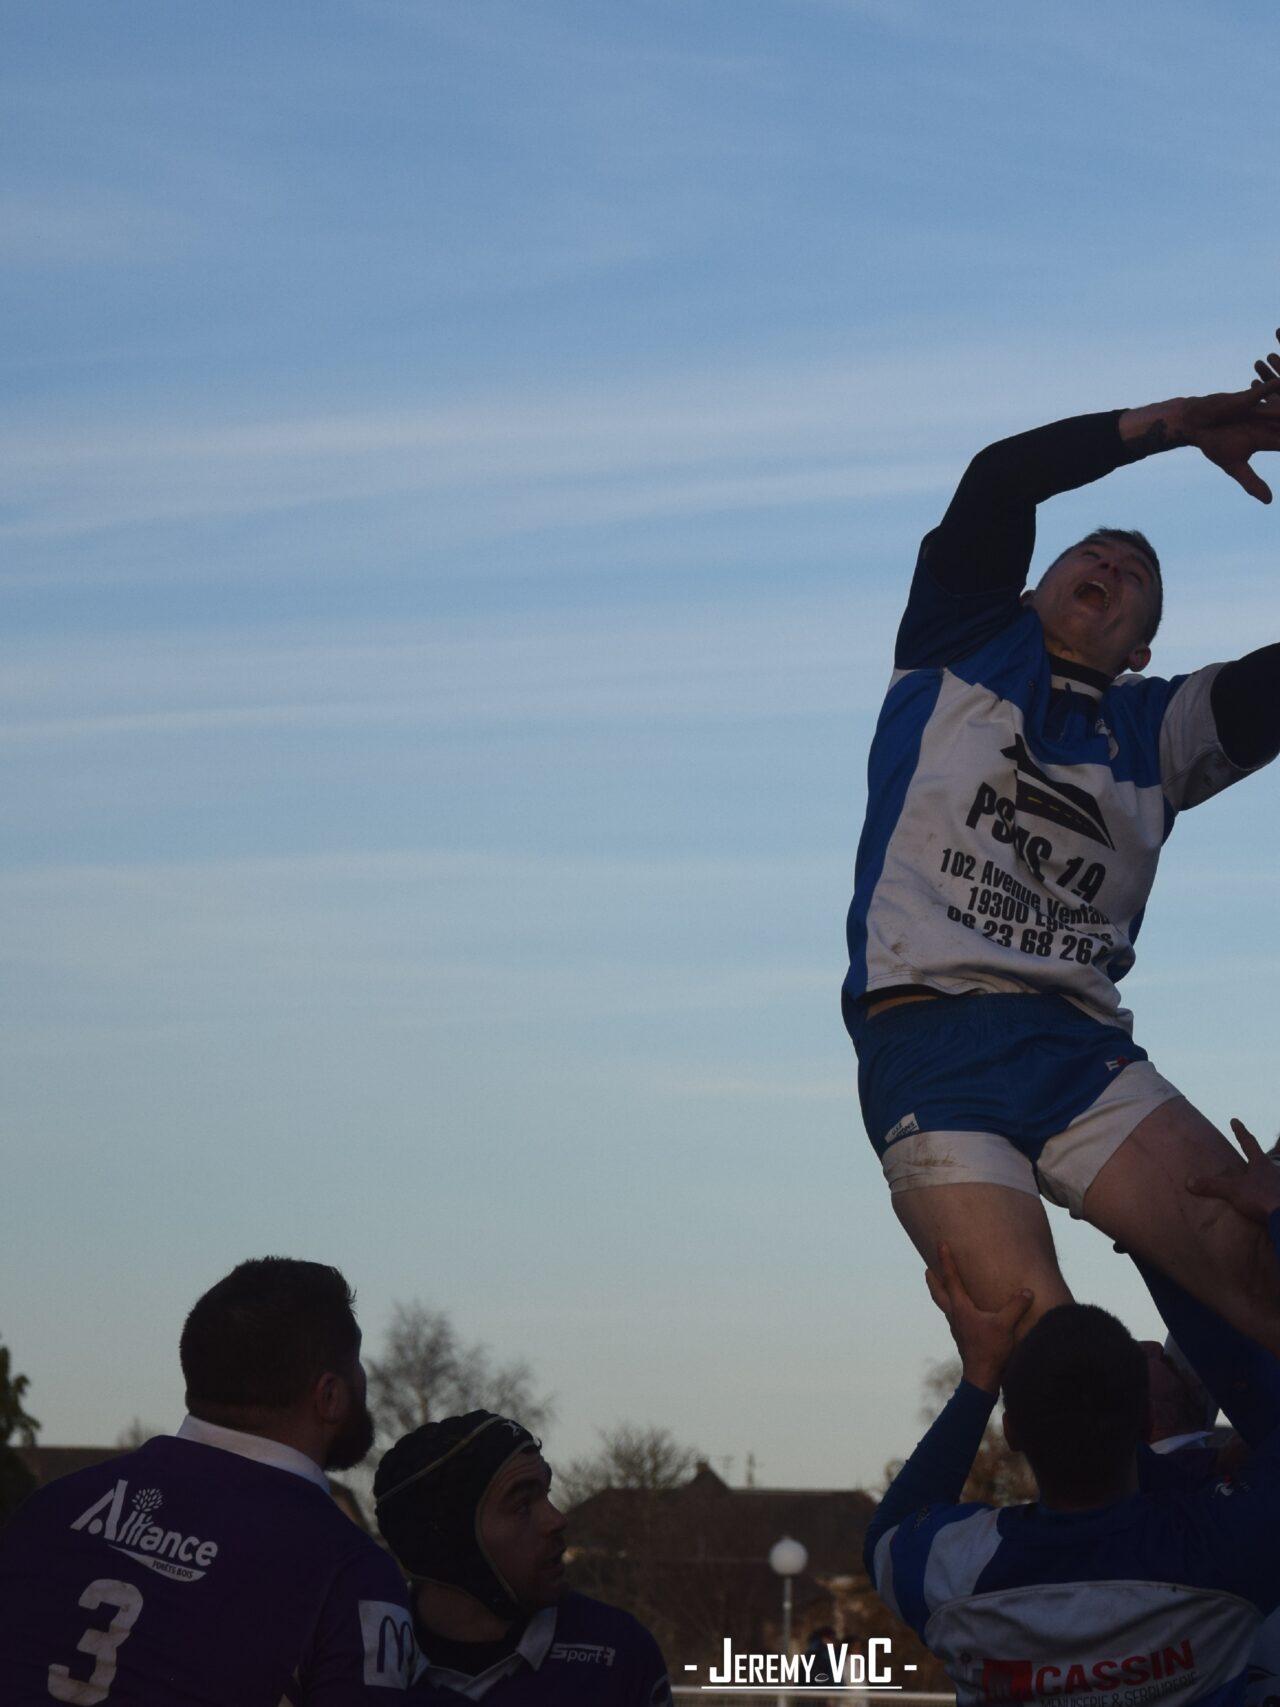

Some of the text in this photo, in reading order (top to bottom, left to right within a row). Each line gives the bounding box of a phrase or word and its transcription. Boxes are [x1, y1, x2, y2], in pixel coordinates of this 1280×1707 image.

[940, 848, 976, 880] 102
[981, 860, 1041, 910] Avenue
[967, 887, 1029, 924] 19300
[982, 920, 1014, 948] 23
[1020, 928, 1053, 957] 68
[1059, 935, 1093, 965] 26
[70, 1479, 219, 1567] Alliance
[48, 1578, 144, 1707] 3
[1035, 1639, 1195, 1698] CASSIN
